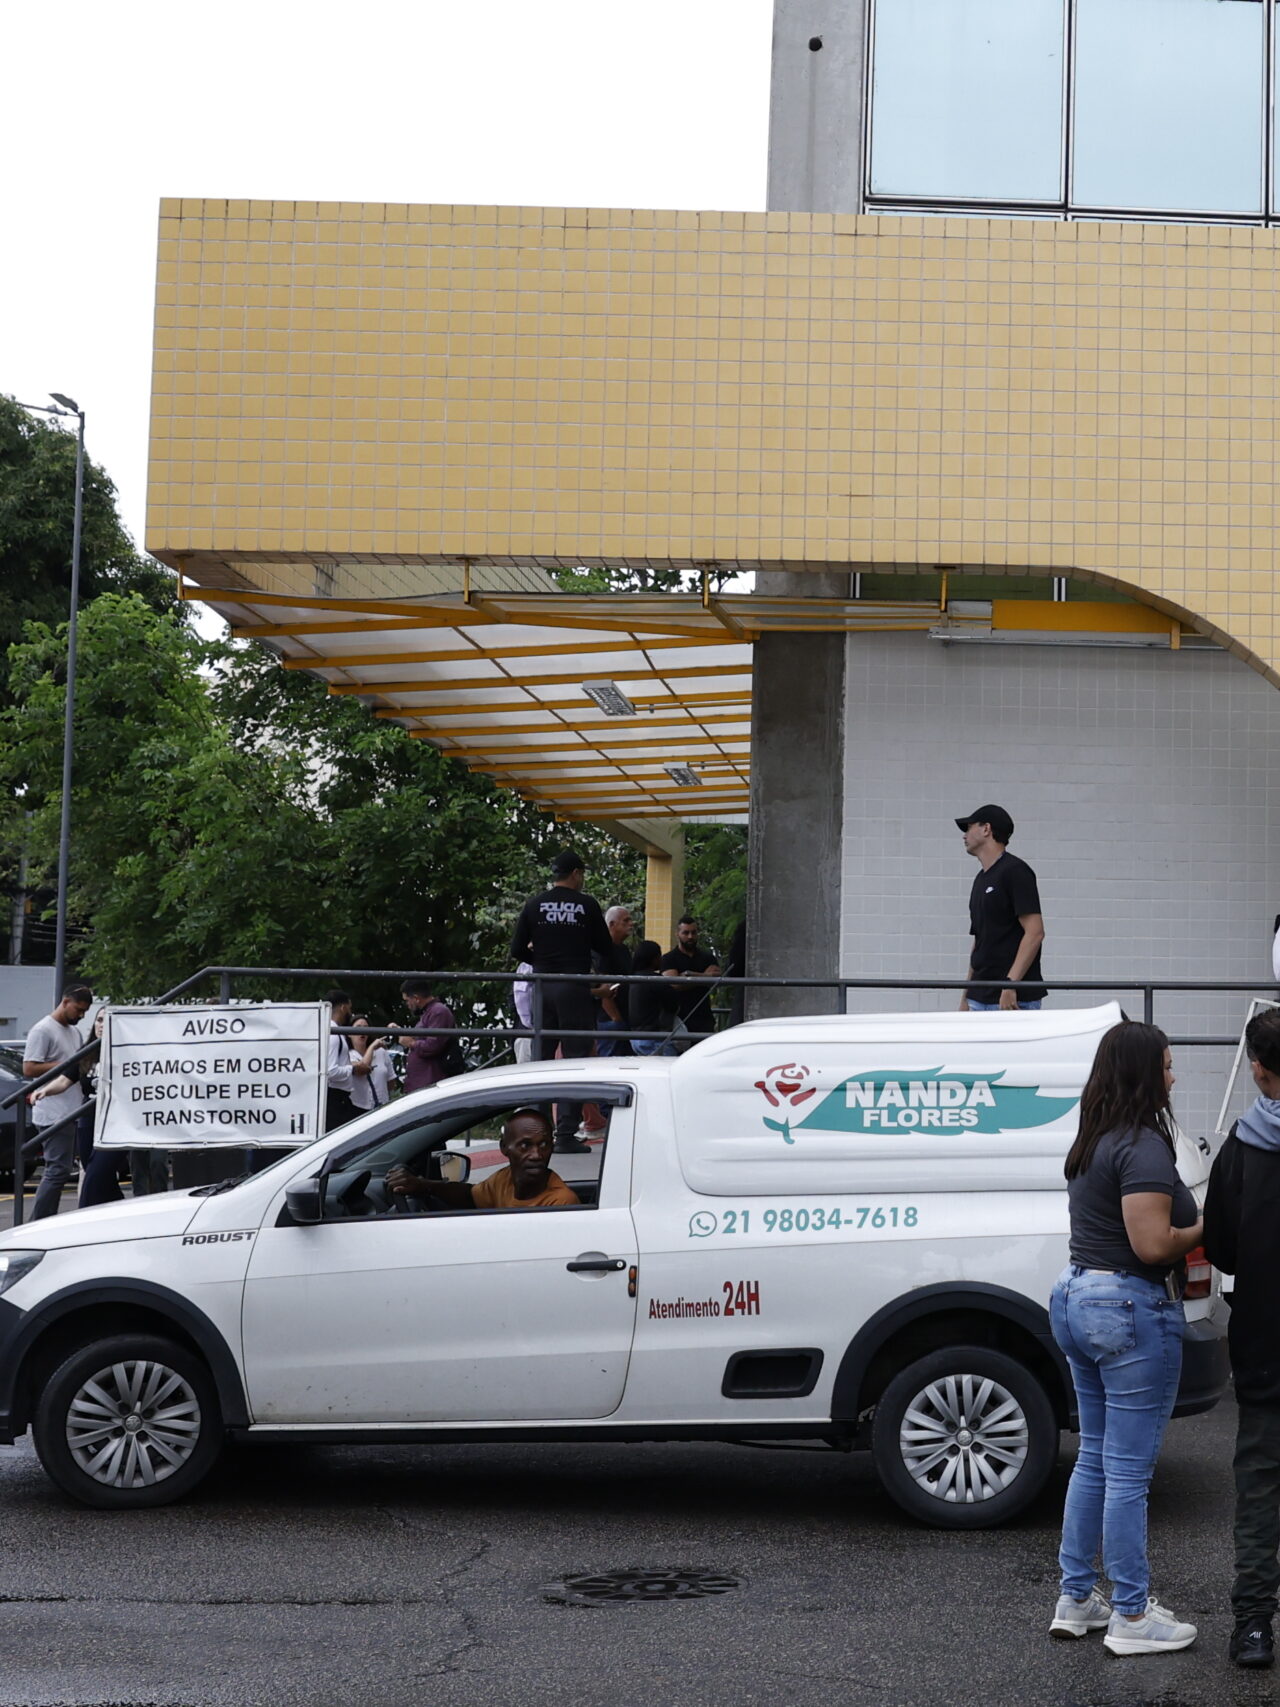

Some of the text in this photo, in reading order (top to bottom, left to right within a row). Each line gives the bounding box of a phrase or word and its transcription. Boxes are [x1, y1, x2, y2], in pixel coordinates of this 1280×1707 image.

[546, 911, 578, 923] CIVIL
[182, 1018, 246, 1037] AVISO
[122, 1057, 306, 1078] ESTAMOS EM OBRA
[131, 1083, 292, 1102] DESCULPE PELO
[845, 1080, 997, 1109] NANDA
[142, 1109, 277, 1127] TRANSTORNO
[862, 1108, 979, 1128] FLORES
[722, 1206, 919, 1234] 21 98034-7618
[181, 1231, 256, 1247] ROBUST
[648, 1280, 761, 1320] Atendimento 24H
